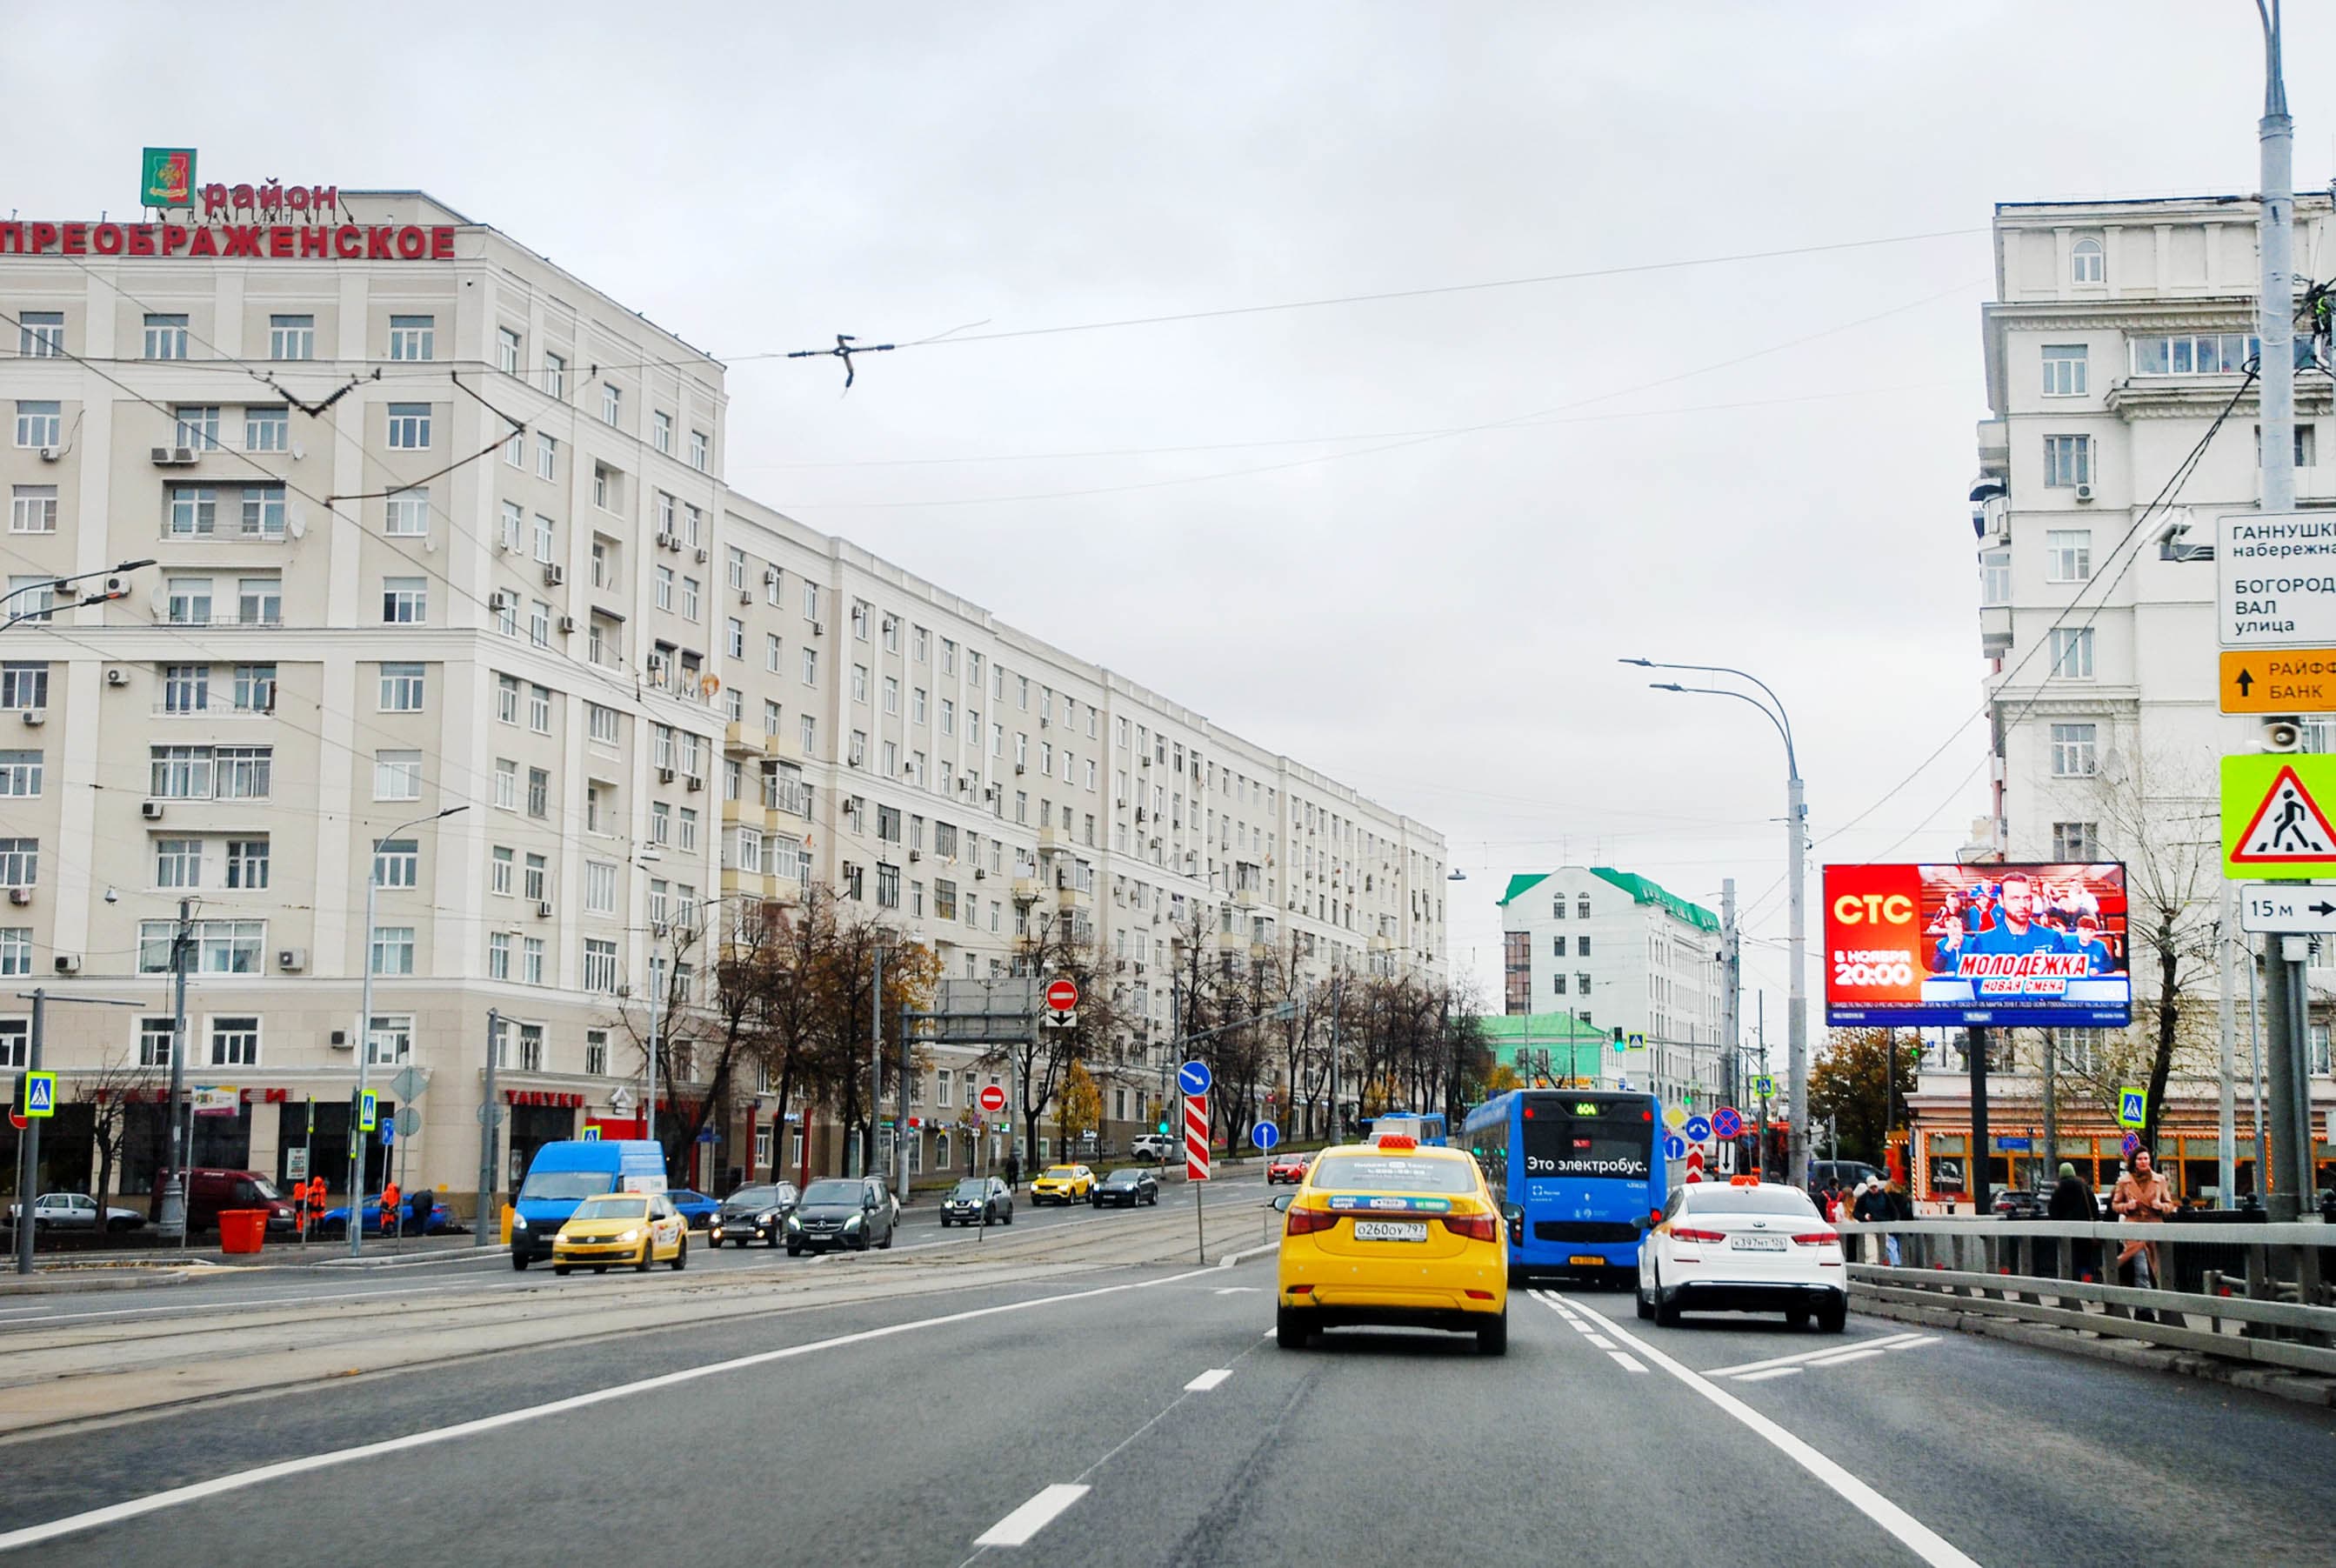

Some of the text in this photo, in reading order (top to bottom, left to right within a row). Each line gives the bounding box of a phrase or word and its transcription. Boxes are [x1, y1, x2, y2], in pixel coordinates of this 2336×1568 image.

[205, 177, 337, 216] район
[0, 223, 456, 258] ПРЕОБРАЖЕНСКОЕ
[2233, 523, 2336, 539] ГАННУШК
[2235, 600, 2276, 615] ВАЛ
[2235, 620, 2294, 637] улица
[2269, 684, 2323, 698] БАНК
[1834, 894, 1912, 924] СТС
[2251, 900, 2273, 917] 15
[1959, 951, 2086, 977] МОЛОДЁЖКА
[1834, 963, 1912, 985] 20:00
[1983, 979, 2064, 991] НОВАЯ СМЕНА
[506, 1090, 584, 1108] ТАНУКИ
[1576, 1103, 1597, 1115] 604
[1527, 1157, 1647, 1173] Это электробус.
